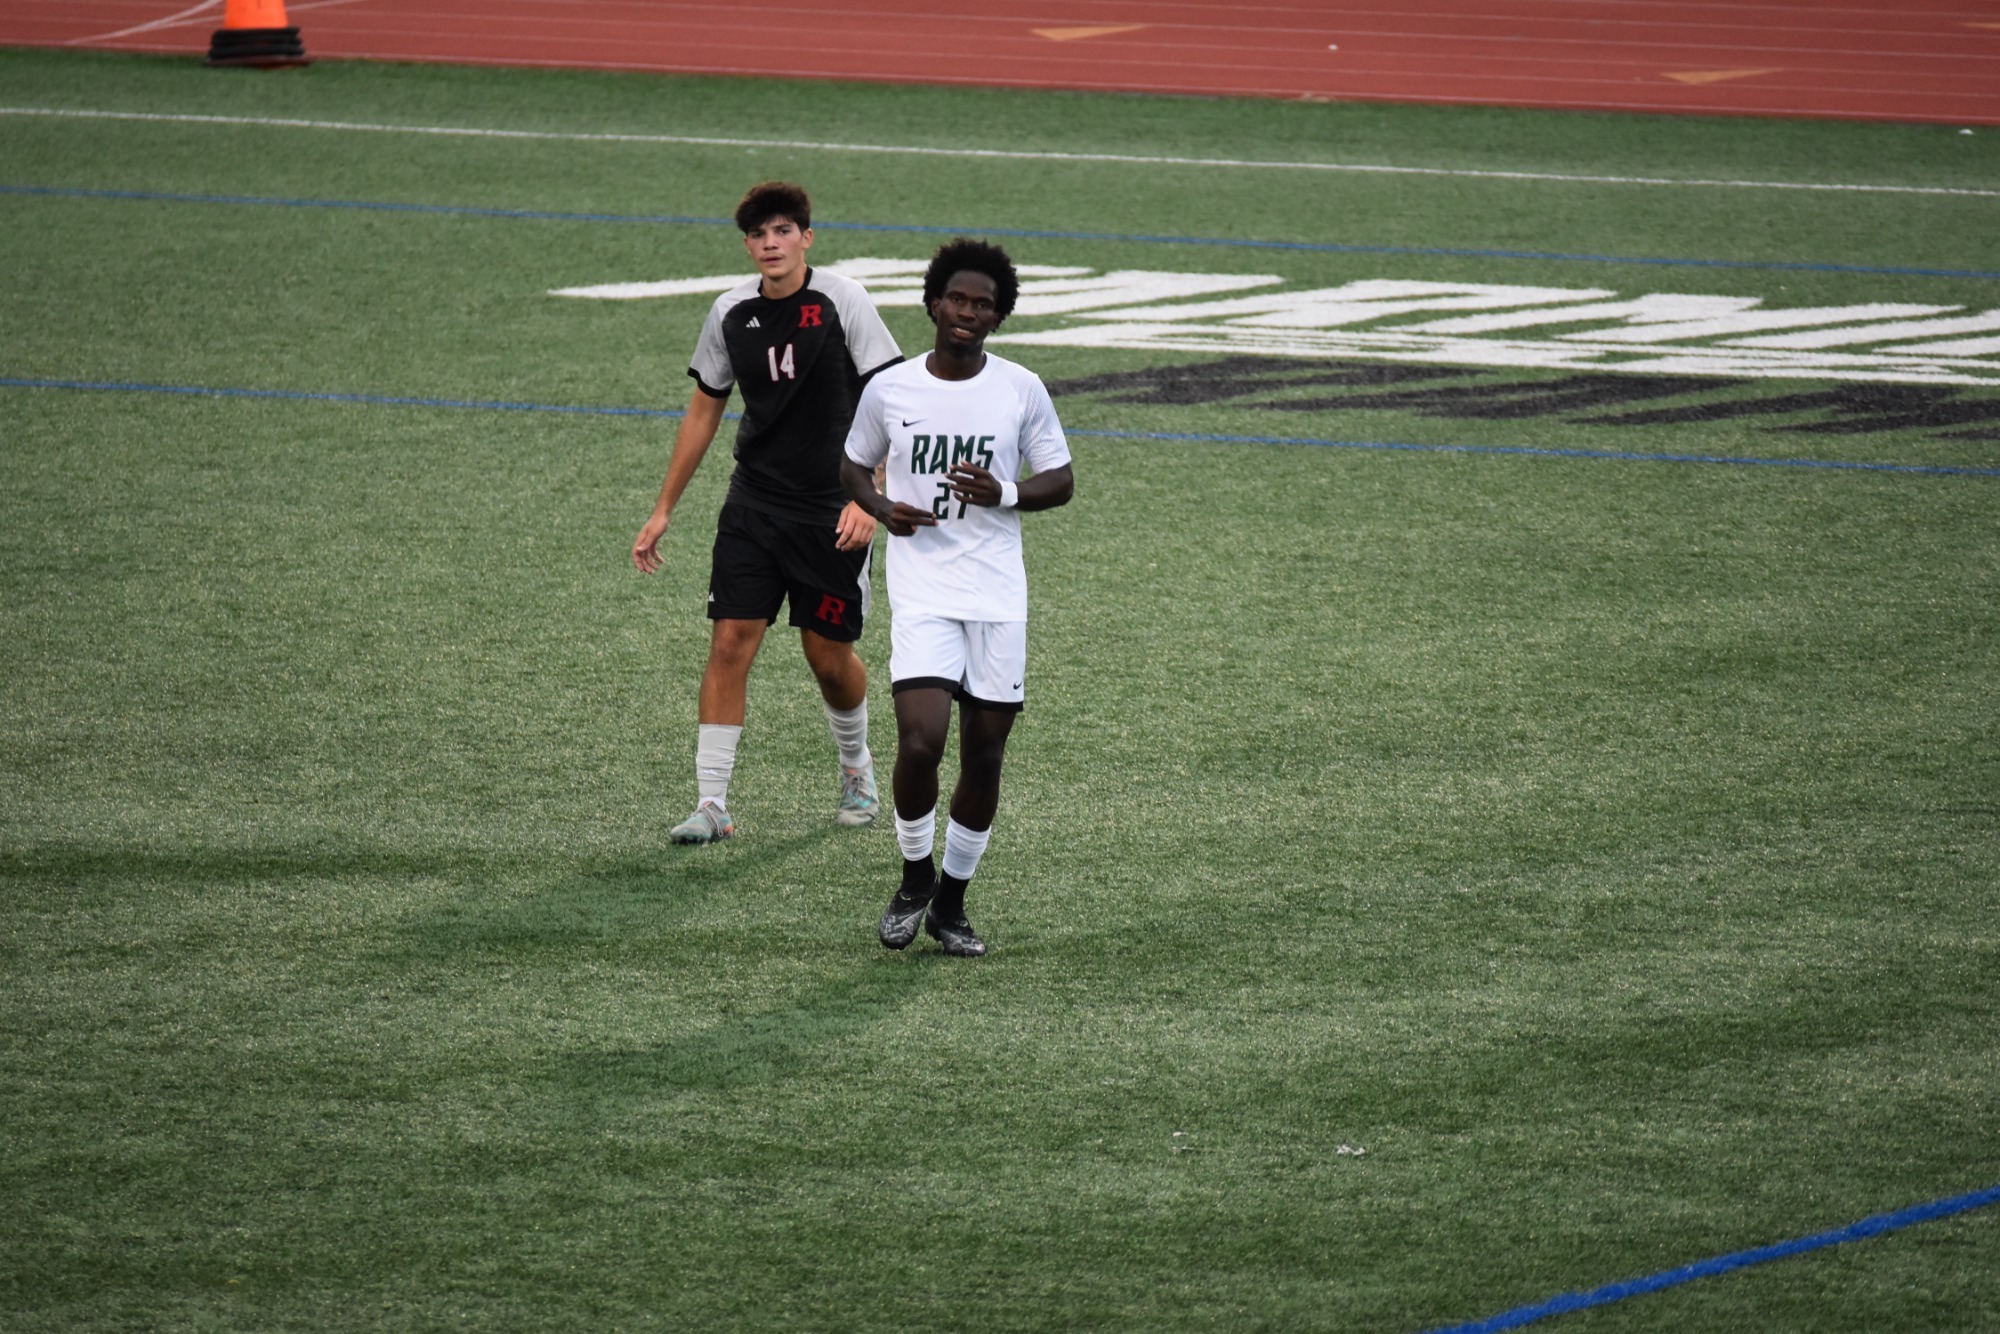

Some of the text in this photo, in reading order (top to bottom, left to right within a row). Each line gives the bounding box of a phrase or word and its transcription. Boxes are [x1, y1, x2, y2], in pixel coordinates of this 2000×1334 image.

[547, 256, 2000, 357] FARMI
[798, 304, 822, 328] R
[768, 343, 795, 382] 14
[1047, 356, 2000, 441] RAM
[911, 434, 995, 474] RAMS
[816, 594, 845, 625] R
